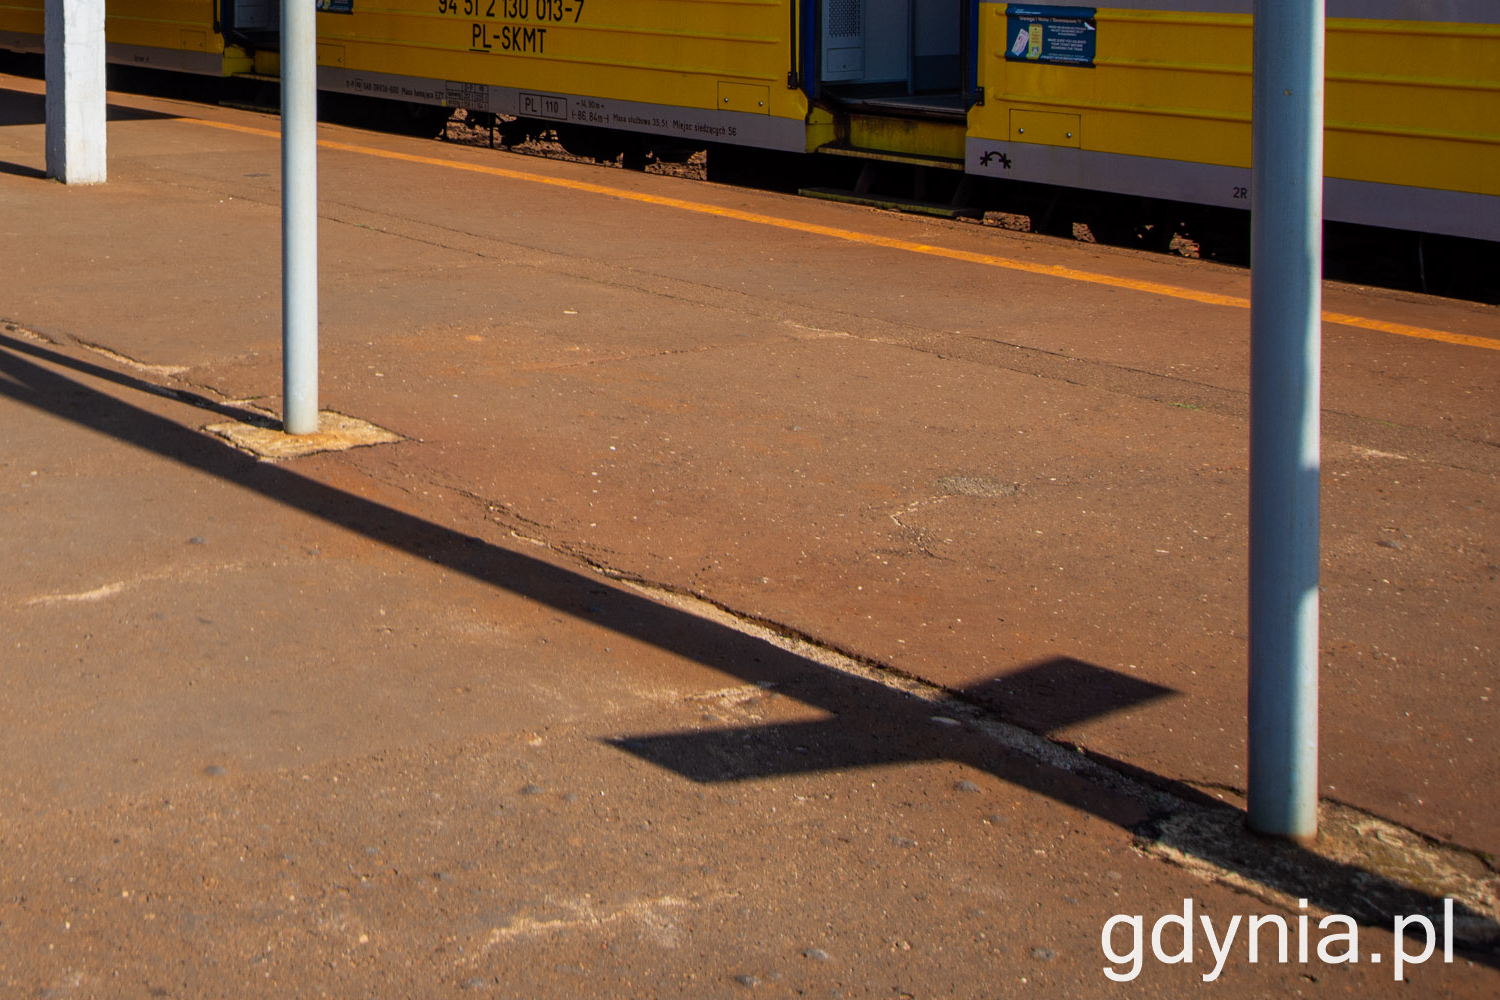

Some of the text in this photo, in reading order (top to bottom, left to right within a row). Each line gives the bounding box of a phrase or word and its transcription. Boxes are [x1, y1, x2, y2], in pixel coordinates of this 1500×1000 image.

[471, 23, 547, 53] PL-SKMT
[525, 97, 559, 114] PL 110
[613, 114, 627, 123] Masa
[672, 119, 693, 132] Miejsc
[694, 121, 726, 137] siedzących
[727, 126, 737, 136] 56
[1232, 186, 1248, 200] 2R
